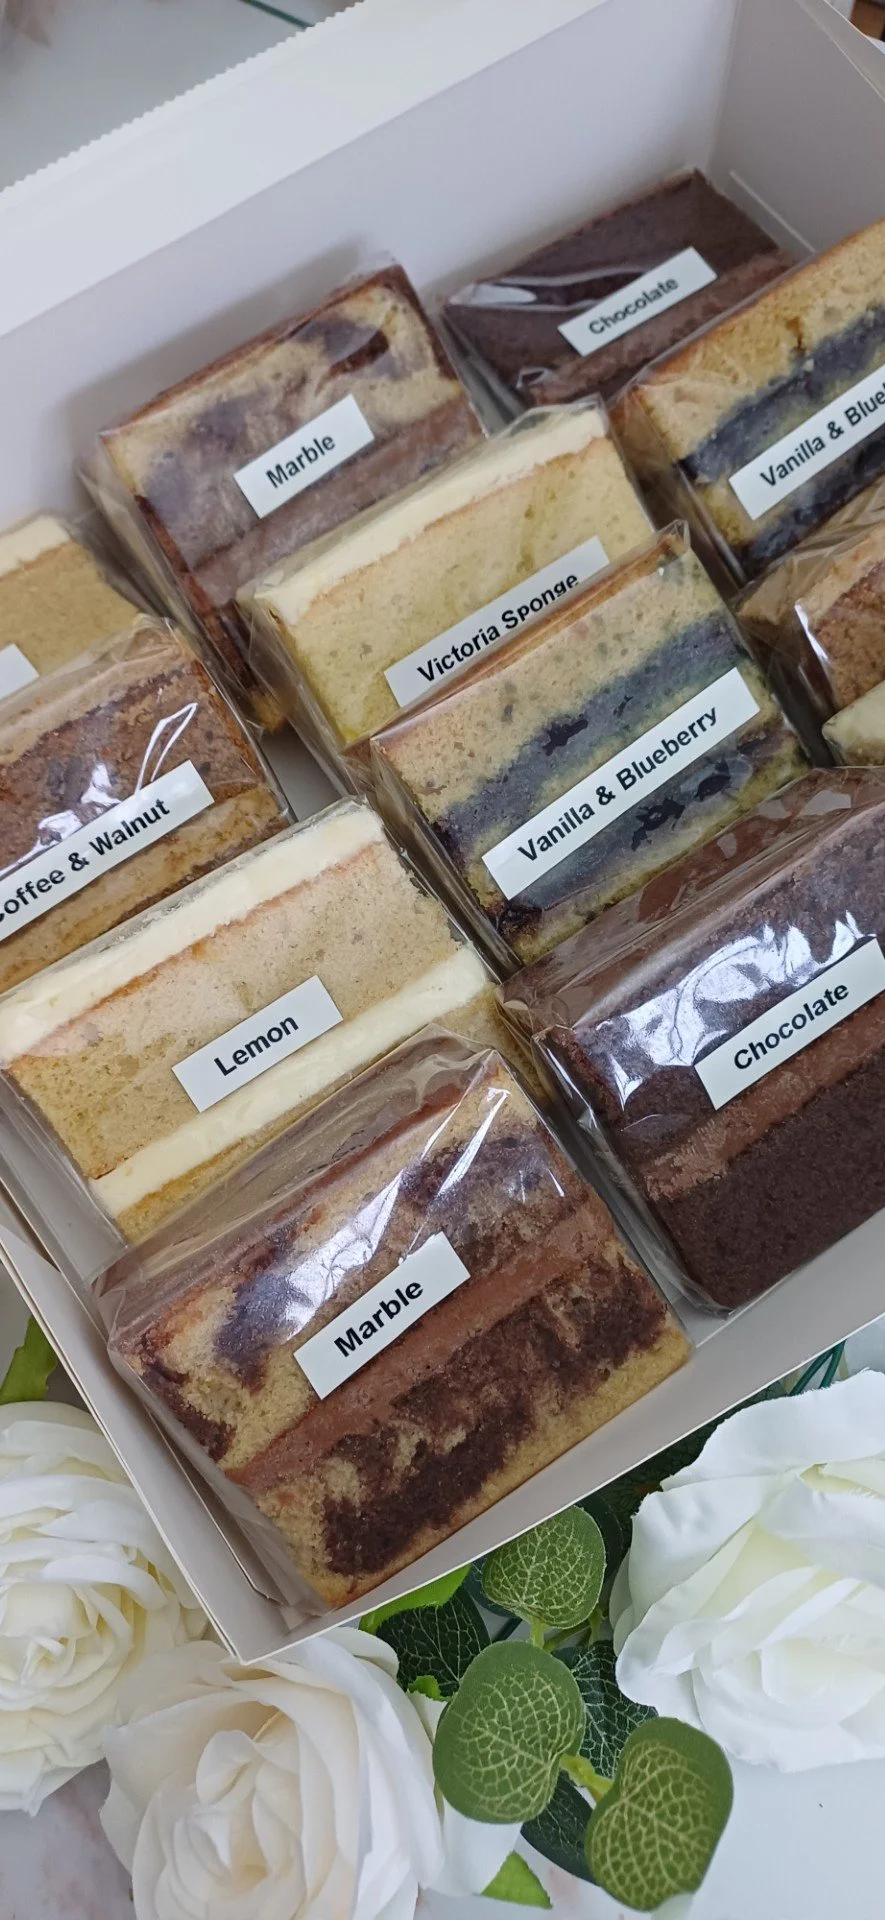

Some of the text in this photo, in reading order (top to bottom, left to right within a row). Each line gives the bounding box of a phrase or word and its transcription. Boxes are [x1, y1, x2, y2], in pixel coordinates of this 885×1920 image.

[588, 277, 680, 335] Chocolate
[265, 435, 336, 489] Marble
[759, 381, 885, 487] Vanilla & Blue
[416, 574, 579, 682] Victoria Sponge
[517, 706, 718, 862] Vanilla & Blueberry
[0, 798, 171, 923] offee & Walnut
[213, 1016, 300, 1077] Lemon
[734, 984, 850, 1070] Chocolate
[333, 1282, 424, 1358] Marble
